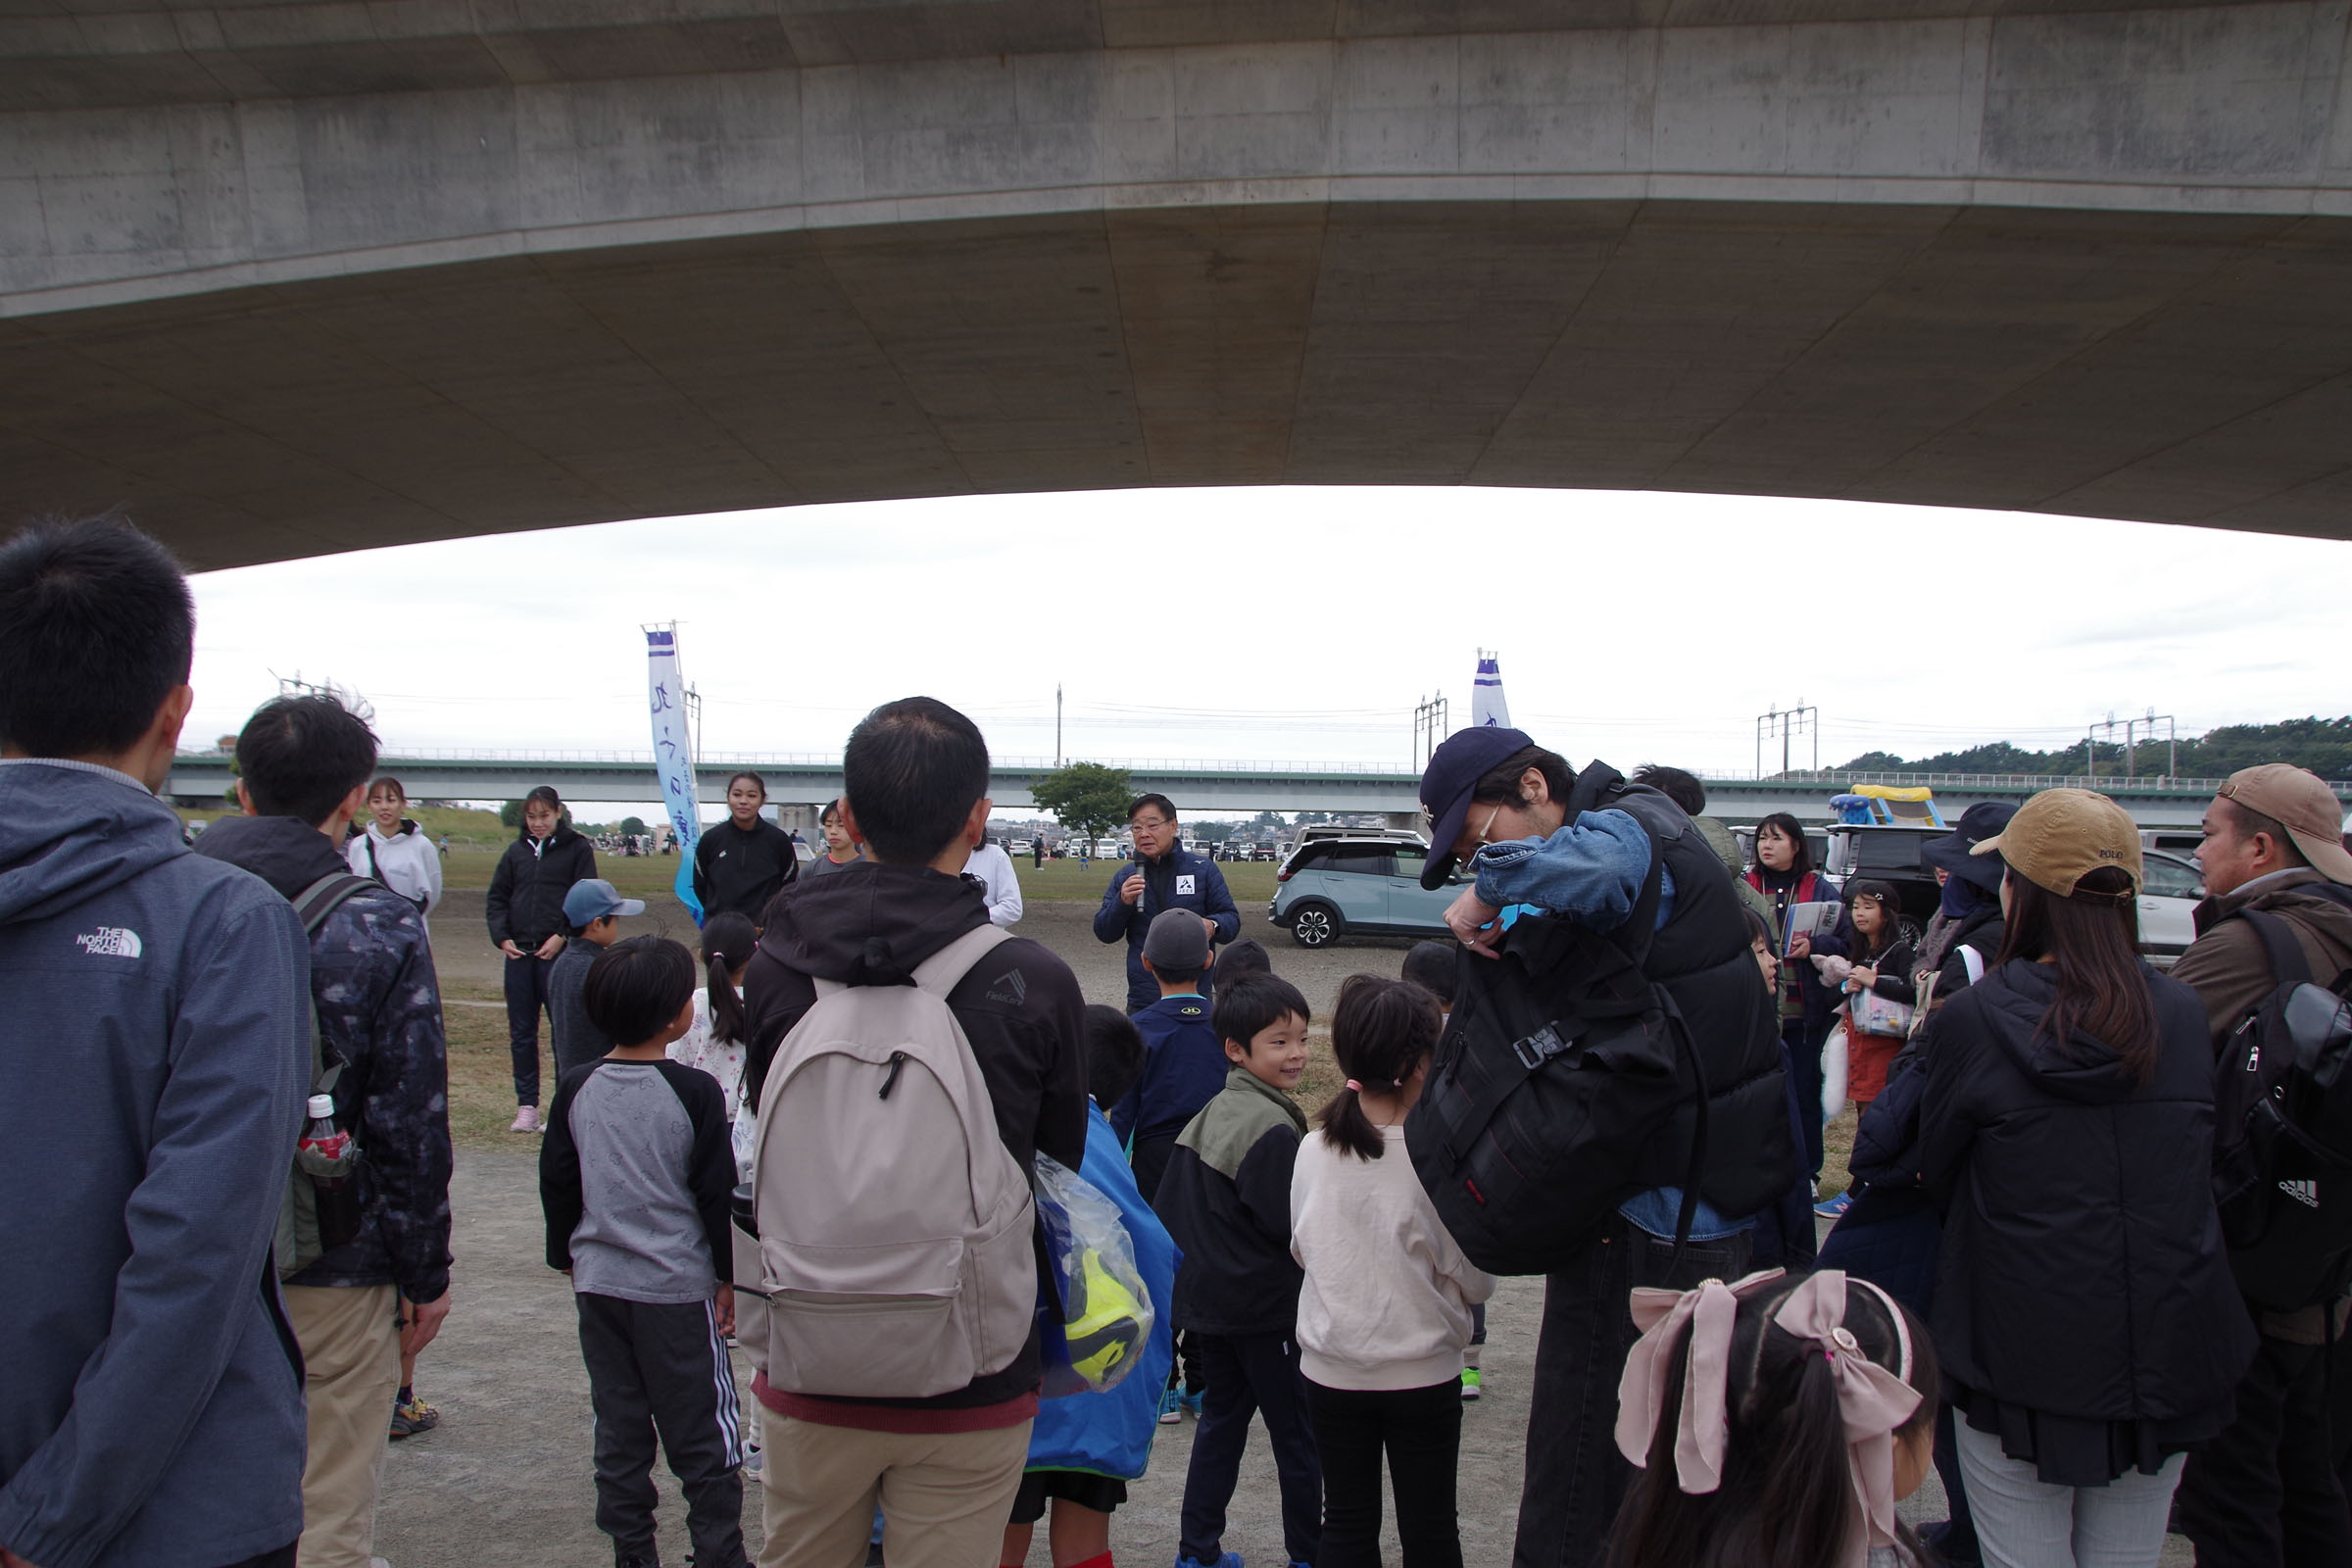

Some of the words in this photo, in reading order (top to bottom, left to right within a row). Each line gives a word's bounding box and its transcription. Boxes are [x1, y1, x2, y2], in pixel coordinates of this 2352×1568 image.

[97, 926, 122, 937] THE
[76, 934, 121, 947] NORTH
[85, 944, 119, 956] FACE
[2278, 1181, 2320, 1207] adidas
